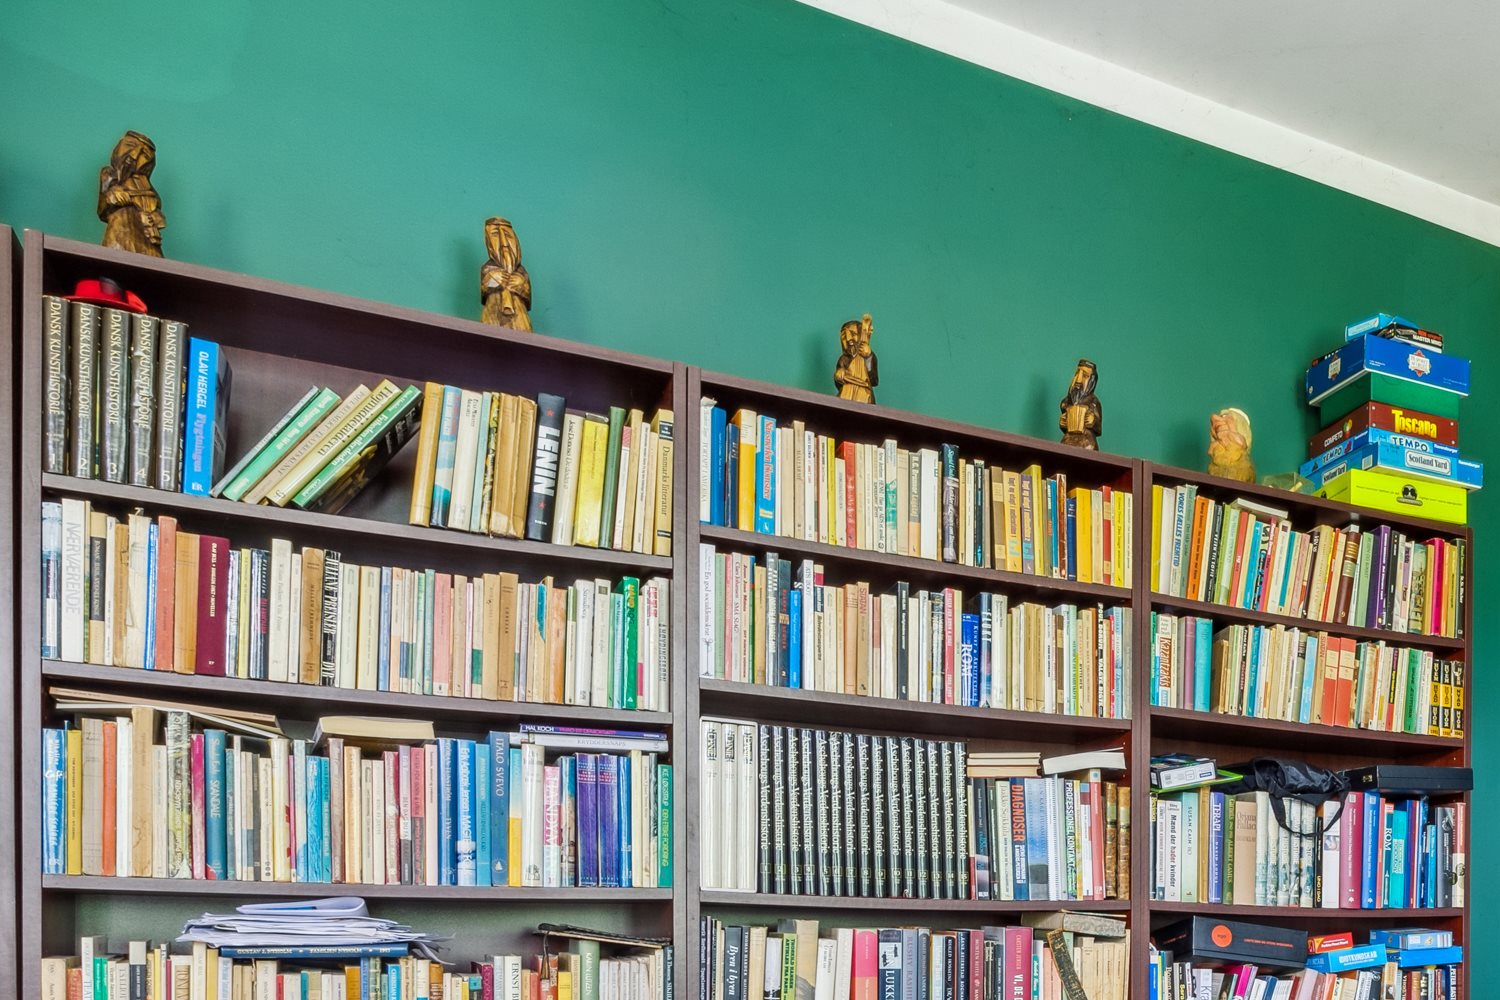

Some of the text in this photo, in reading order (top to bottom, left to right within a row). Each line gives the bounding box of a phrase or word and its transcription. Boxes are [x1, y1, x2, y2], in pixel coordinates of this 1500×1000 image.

[49, 302, 61, 414] DANSK KUNSTHISTORIE
[79, 308, 91, 418] DANSK KUNSTHISTORIE
[1413, 334, 1442, 347] MASTER MIND
[109, 314, 121, 424] DANSK KUNSTHISTORIE
[138, 320, 151, 429] DANSK KUNSTHISTORIE
[163, 324, 176, 433] DANSK KUNSTHISTORIE
[193, 352, 209, 472] OLAV HERGEL Flygtningen
[80, 458, 87, 469] 2
[533, 425, 560, 497] LENIN
[1322, 446, 1342, 464] TEMPO
[1324, 431, 1343, 448] COMPETO
[1391, 436, 1429, 453] TEMPO
[1408, 455, 1448, 470] Scotland Yard
[109, 462, 116, 474] 3
[137, 468, 145, 479] 4
[163, 471, 170, 481] 5
[661, 446, 670, 516] Danmarks litteratur
[1176, 514, 1184, 537] FÆLLES
[65, 522, 81, 615] NÆRVÆRENDE
[1173, 538, 1182, 567] FREMTID
[322, 557, 339, 678] JULIANE PREISLER DYR
[703, 571, 712, 636] En god socialdemokrat
[982, 611, 991, 642] FLUKT
[961, 643, 972, 677] ROM
[1160, 638, 1171, 688] Kazantzakis
[495, 737, 504, 796] ITALO SVEVO
[759, 733, 771, 849] Aschehougs Verdenshistorie
[789, 736, 801, 852] Aschehougs Verdenshistorie
[817, 739, 829, 853] Aschehougs Verdenshistorie
[844, 741, 855, 855] Aschehougs Verdenshistorie
[873, 743, 885, 857] Aschehougs Verdenshistorie
[902, 745, 913, 856] Aschehougs Verdenshistorie
[928, 749, 940, 859] Aschehougs Verdenshistorie
[957, 750, 968, 860] Aschehougs Verdenshistorie
[1011, 785, 1025, 841] DIAGNOSER
[1066, 782, 1075, 834] PROFESSIONEL
[1213, 803, 1222, 831] TERAPI
[1384, 827, 1392, 850] ROM
[176, 969, 188, 991] TONI
[728, 945, 739, 966] Byen
[1013, 974, 1023, 985] VI,
[727, 975, 737, 995] byen
[1014, 987, 1023, 995] DE
